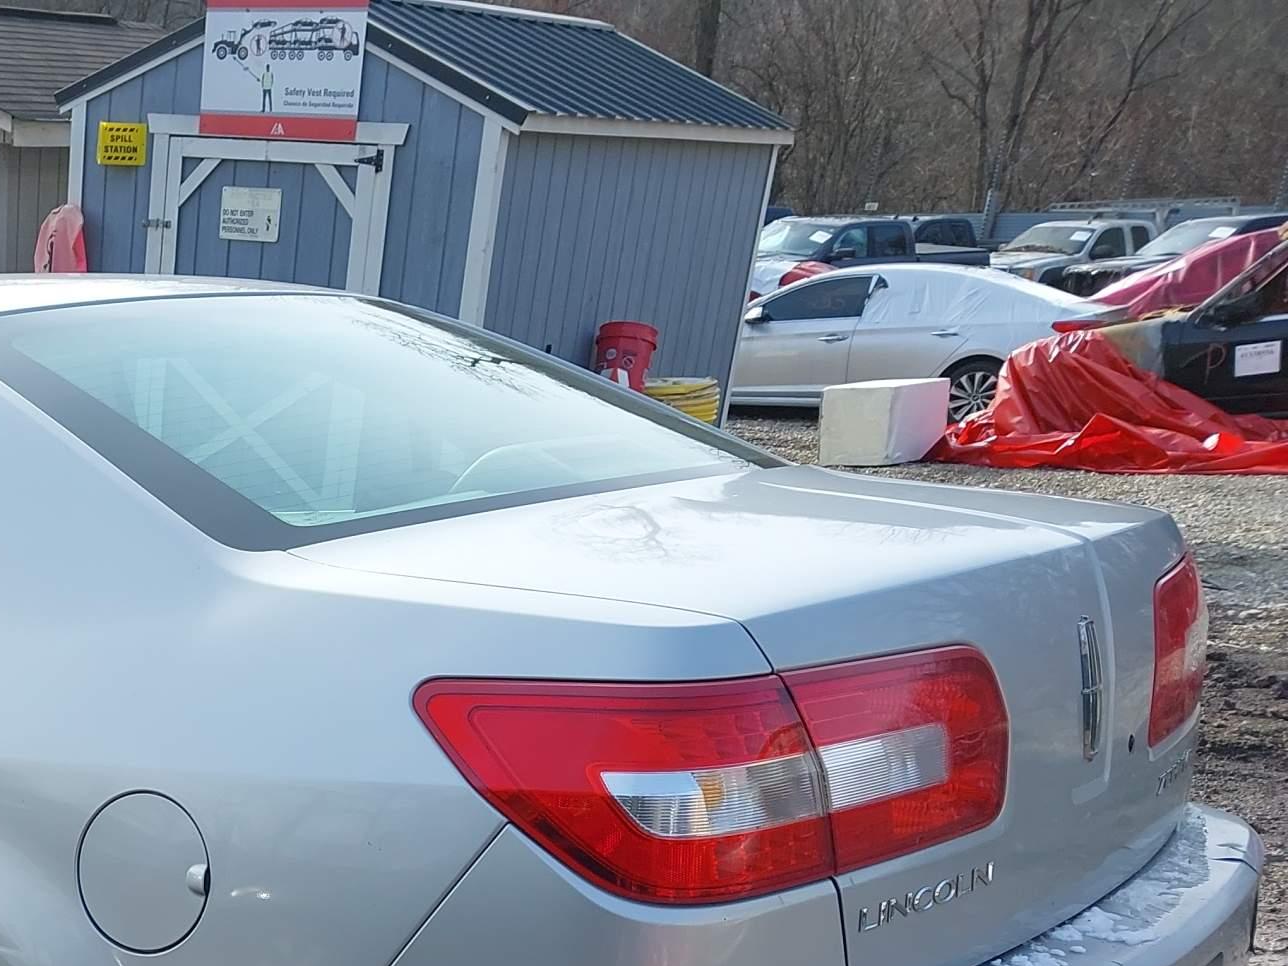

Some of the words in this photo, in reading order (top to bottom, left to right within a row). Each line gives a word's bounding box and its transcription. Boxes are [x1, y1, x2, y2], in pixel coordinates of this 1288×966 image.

[284, 87, 305, 98] Safety
[307, 88, 322, 97] Vest
[323, 88, 354, 99] Required
[110, 134, 133, 143] SPILL
[103, 145, 138, 153] STATION
[223, 208, 229, 216] DO
[230, 209, 239, 217] NOT
[239, 209, 254, 218] ENTER
[247, 227, 259, 235] ONLY
[857, 860, 995, 933] LINCOLN
